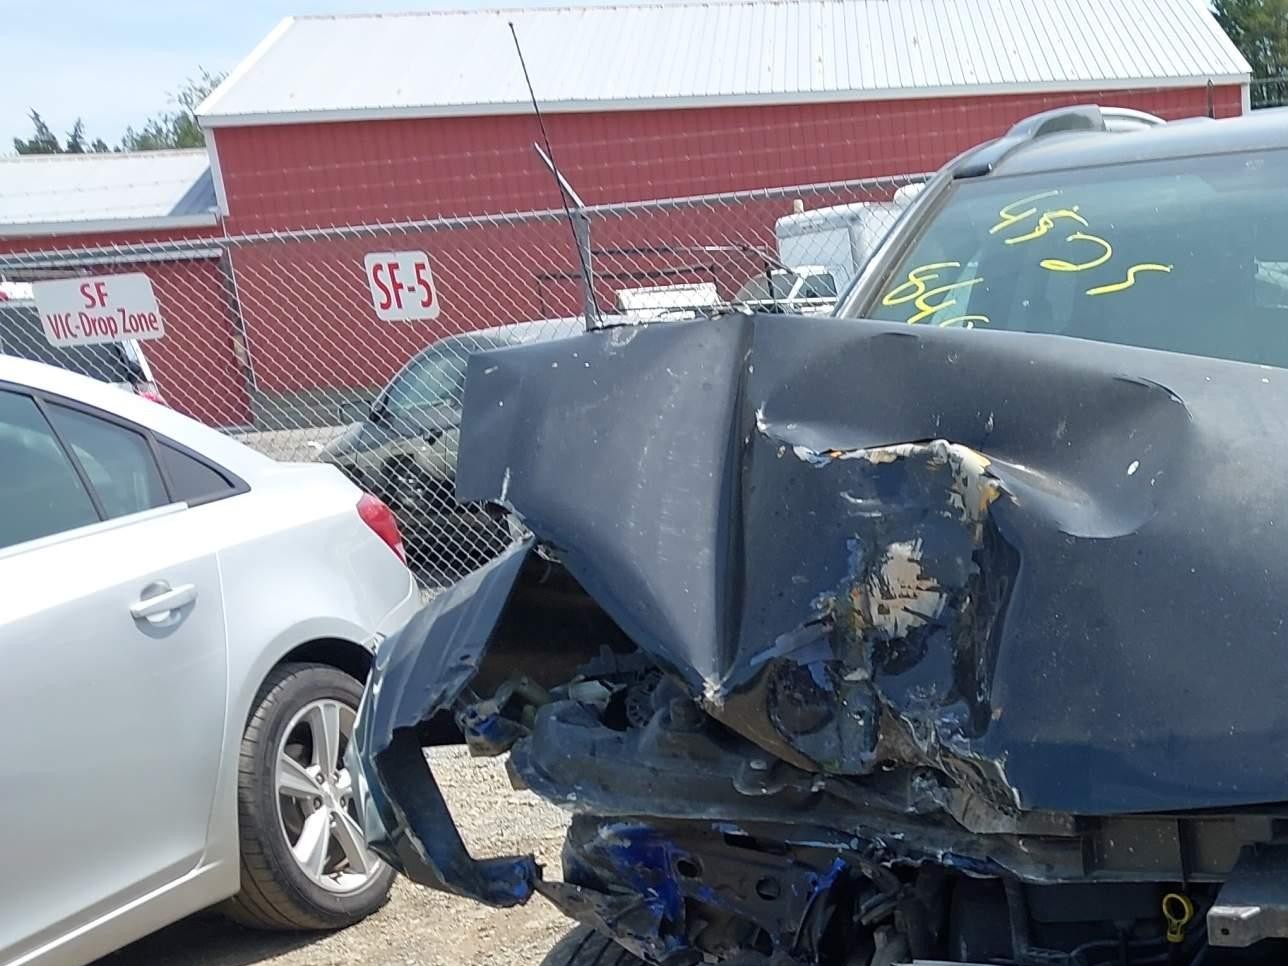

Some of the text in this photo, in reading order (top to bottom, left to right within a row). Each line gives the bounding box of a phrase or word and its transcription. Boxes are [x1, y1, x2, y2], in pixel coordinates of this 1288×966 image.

[79, 281, 109, 309] SF
[372, 262, 432, 310] SF-5
[46, 307, 160, 340] VIC-Drop Zone
